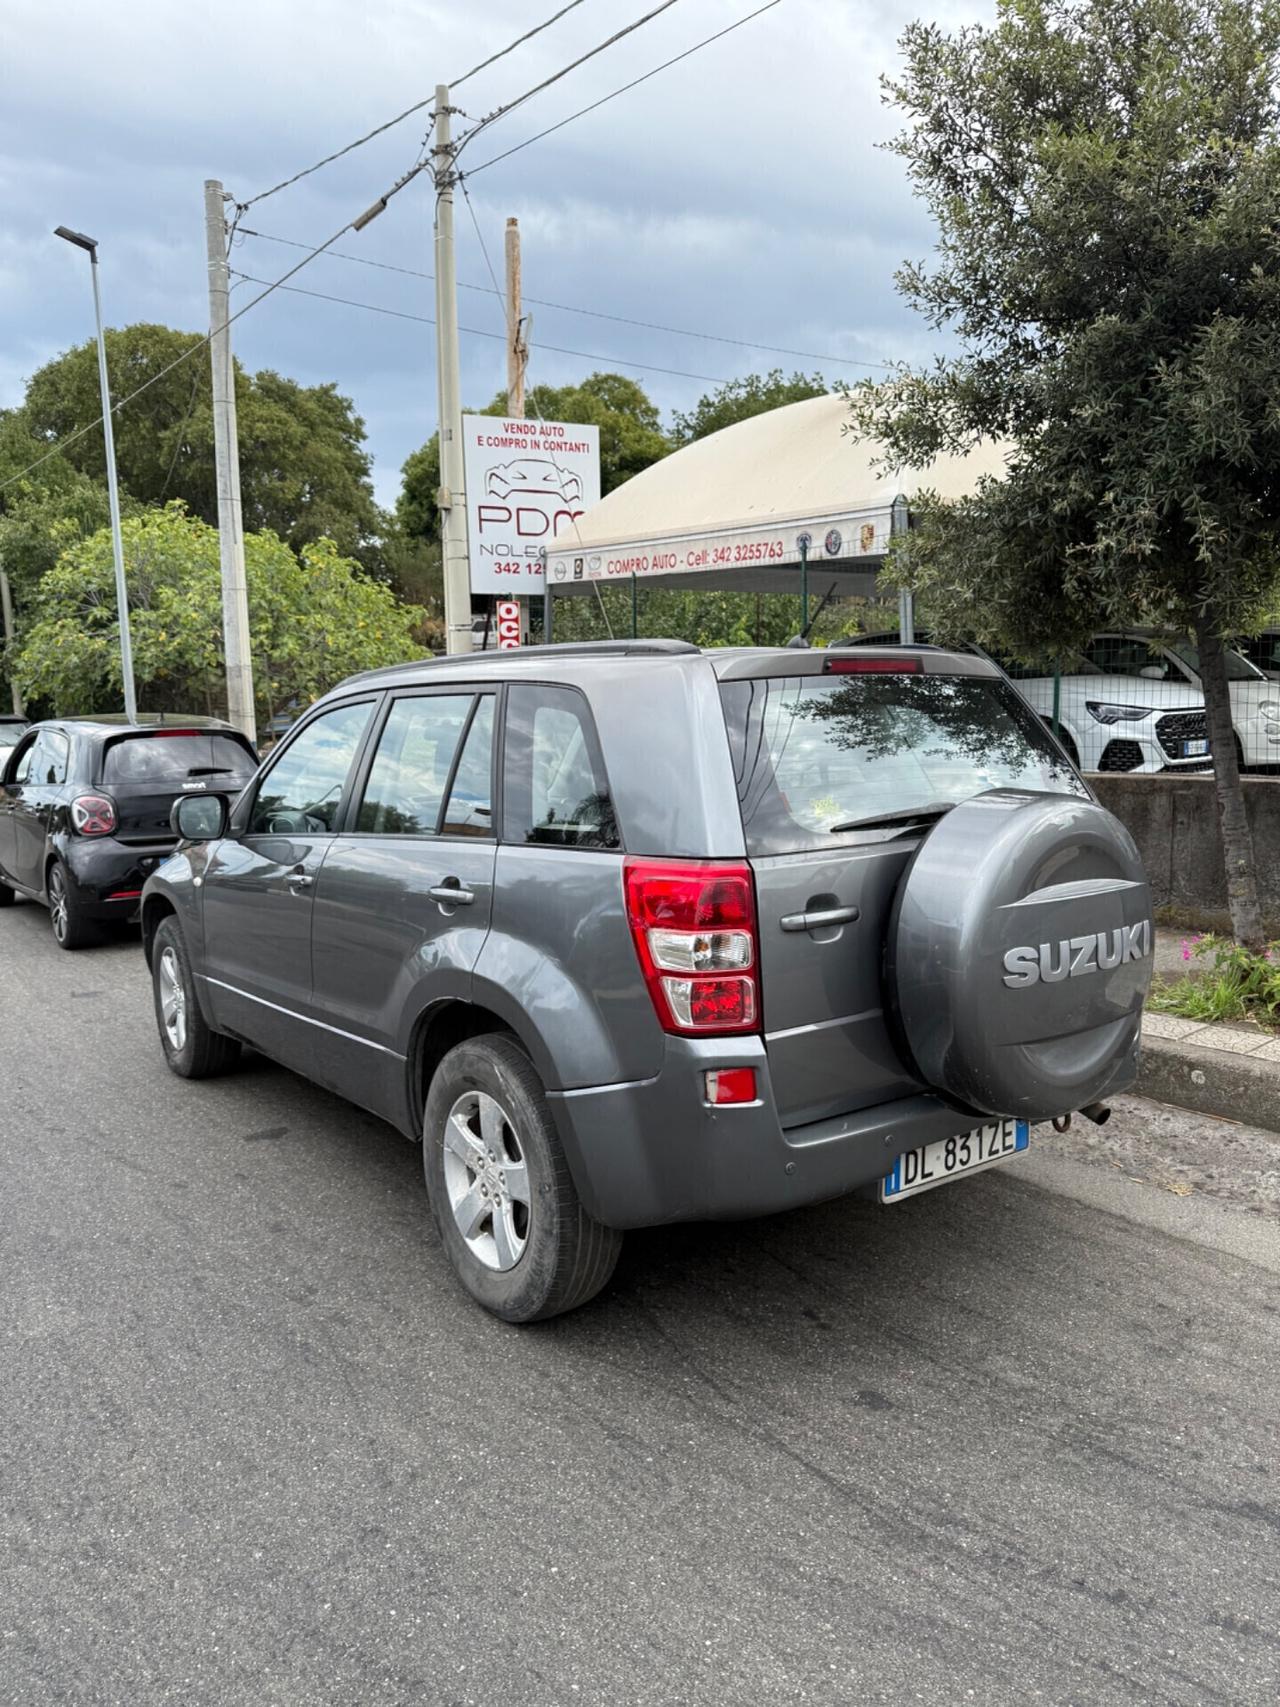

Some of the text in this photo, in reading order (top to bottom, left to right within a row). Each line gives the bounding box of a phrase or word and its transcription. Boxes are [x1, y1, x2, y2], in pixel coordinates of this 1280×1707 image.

[503, 422, 565, 438] VENDO AUTO
[477, 435, 590, 454] E COMPRO IN CONTANTI
[494, 561, 546, 575] 342 12
[607, 556, 649, 574] COMPRO
[652, 553, 677, 569] AUTO
[687, 550, 710, 567] Cell:
[712, 546, 732, 564] 342
[734, 541, 784, 562] 3255763
[1003, 919, 1150, 989] SUZUKI
[904, 1145, 934, 1185] DL
[944, 1119, 1015, 1172] 831ZE
